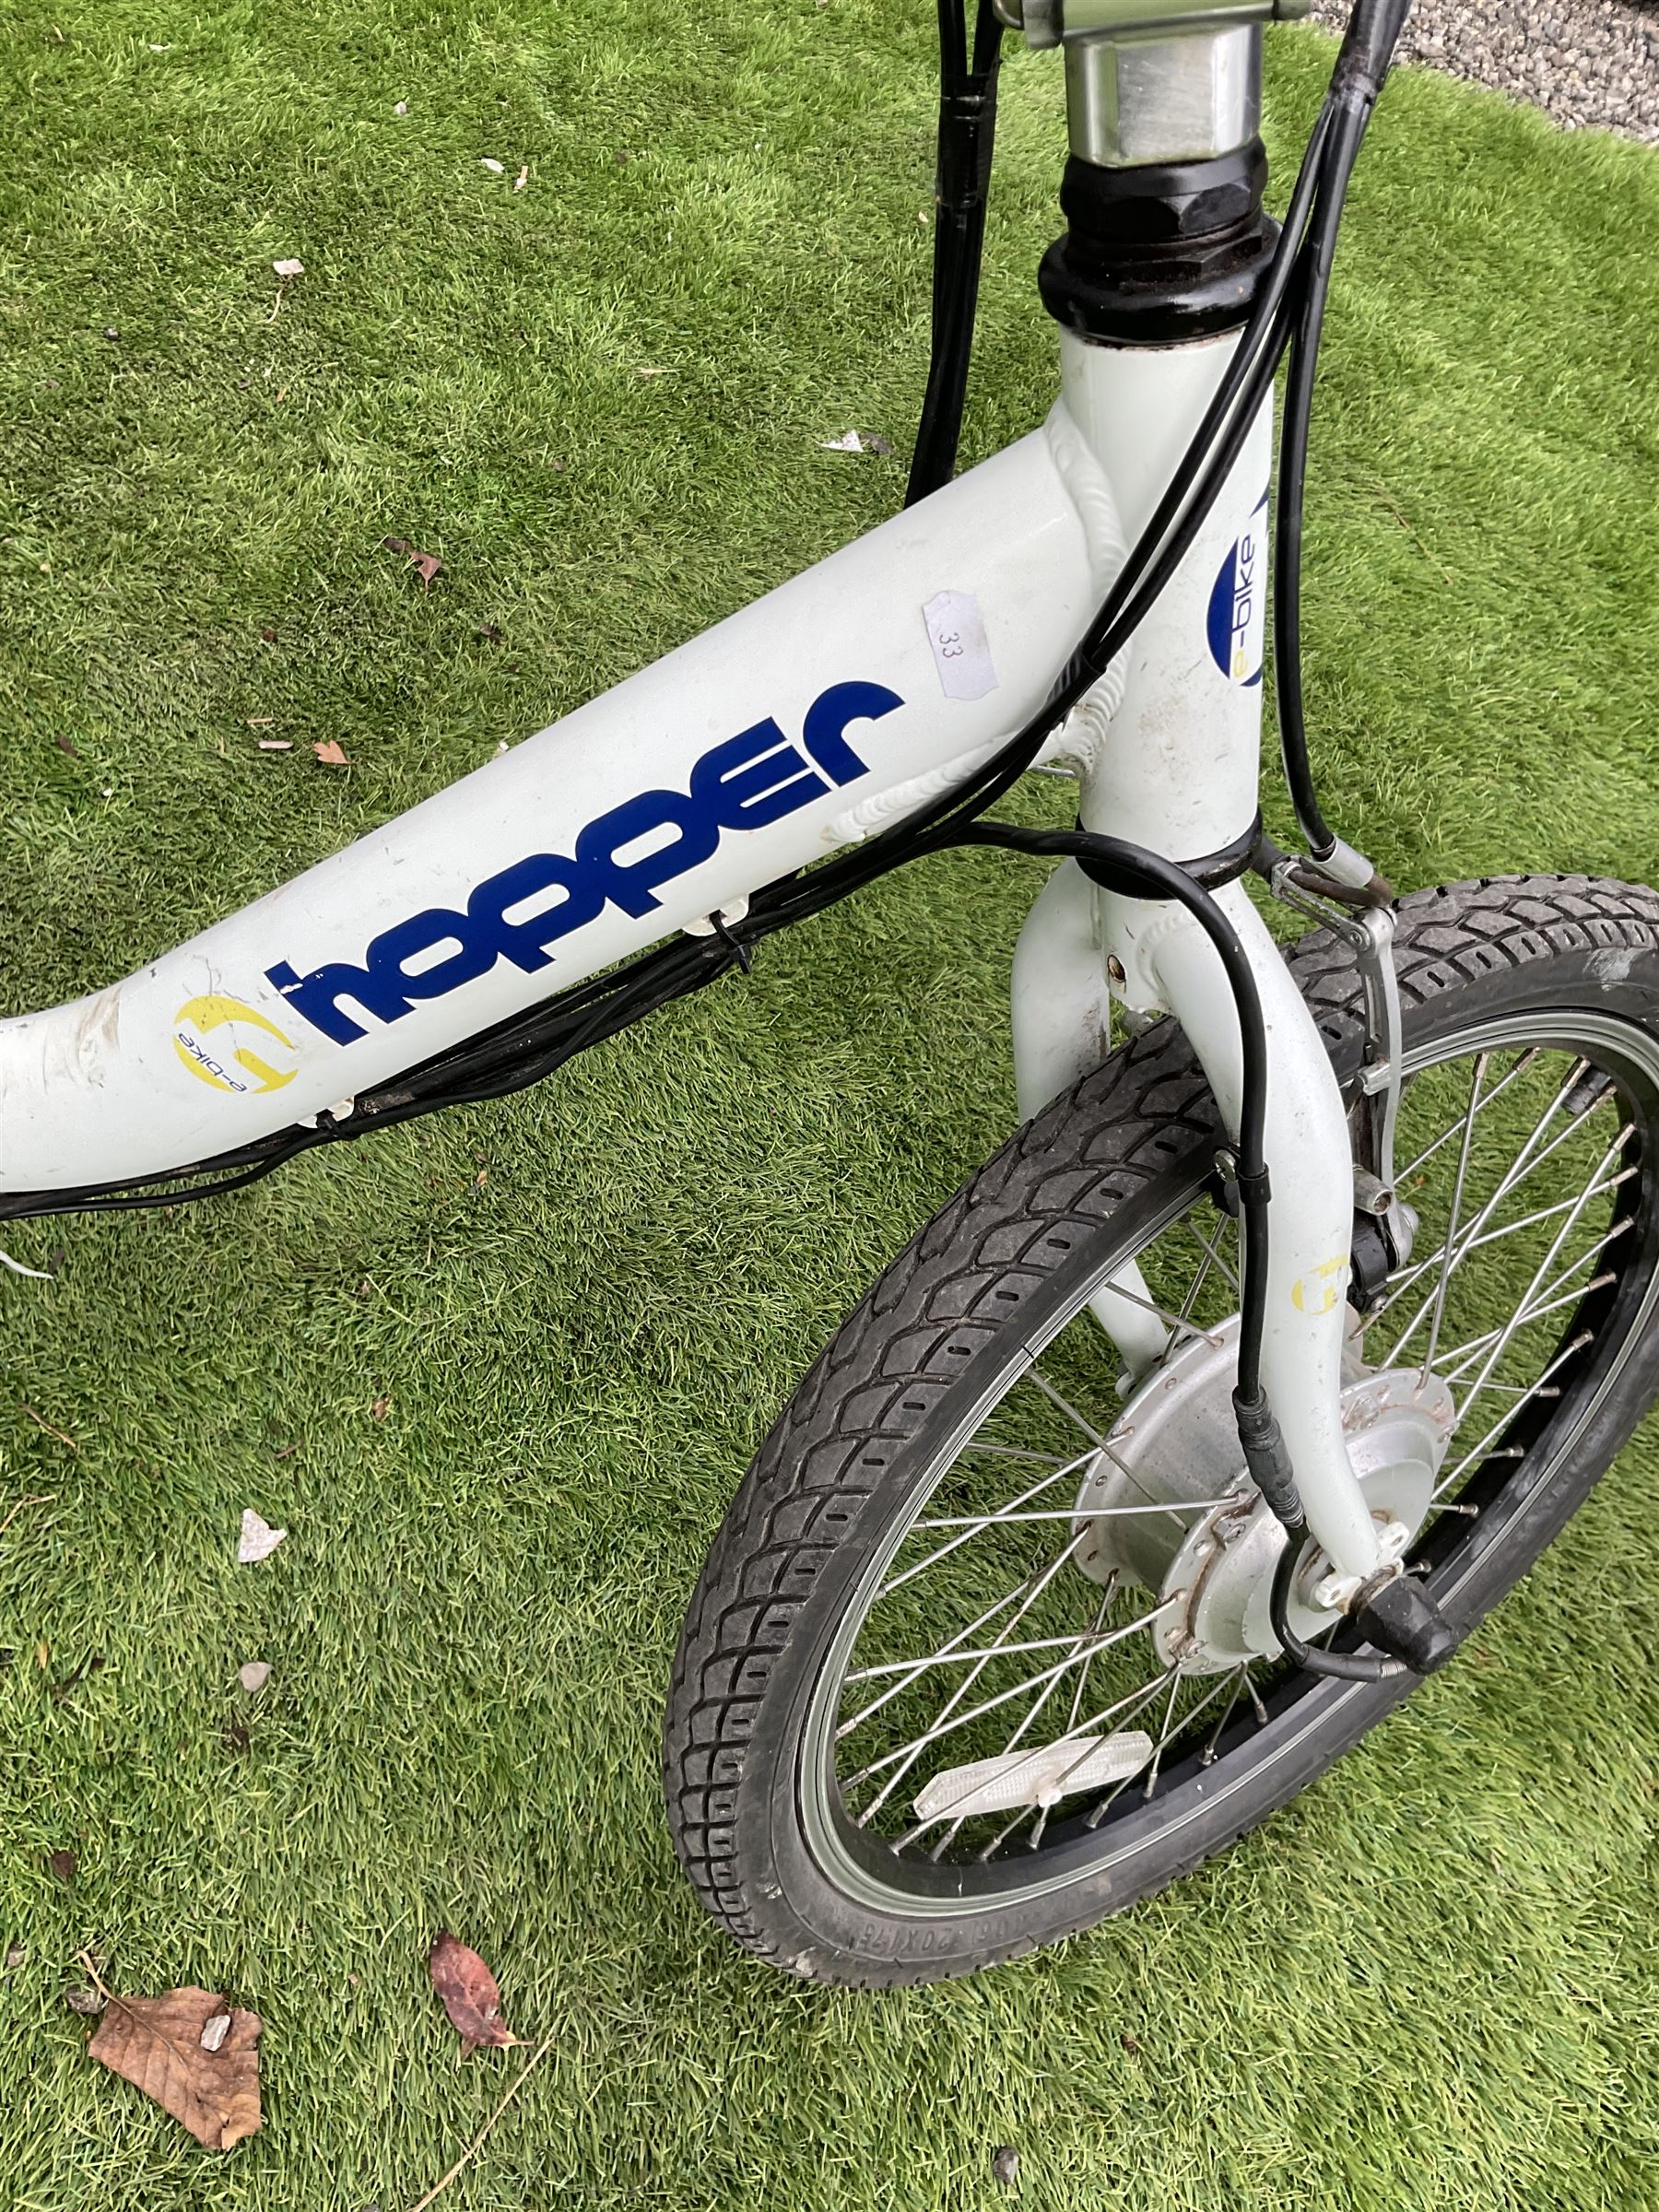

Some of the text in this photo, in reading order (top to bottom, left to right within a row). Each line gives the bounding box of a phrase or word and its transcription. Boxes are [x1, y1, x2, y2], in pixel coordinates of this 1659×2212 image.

[1231, 533, 1256, 679] e-bike
[939, 632, 964, 658] 33
[178, 1032, 248, 1093] e-bike
